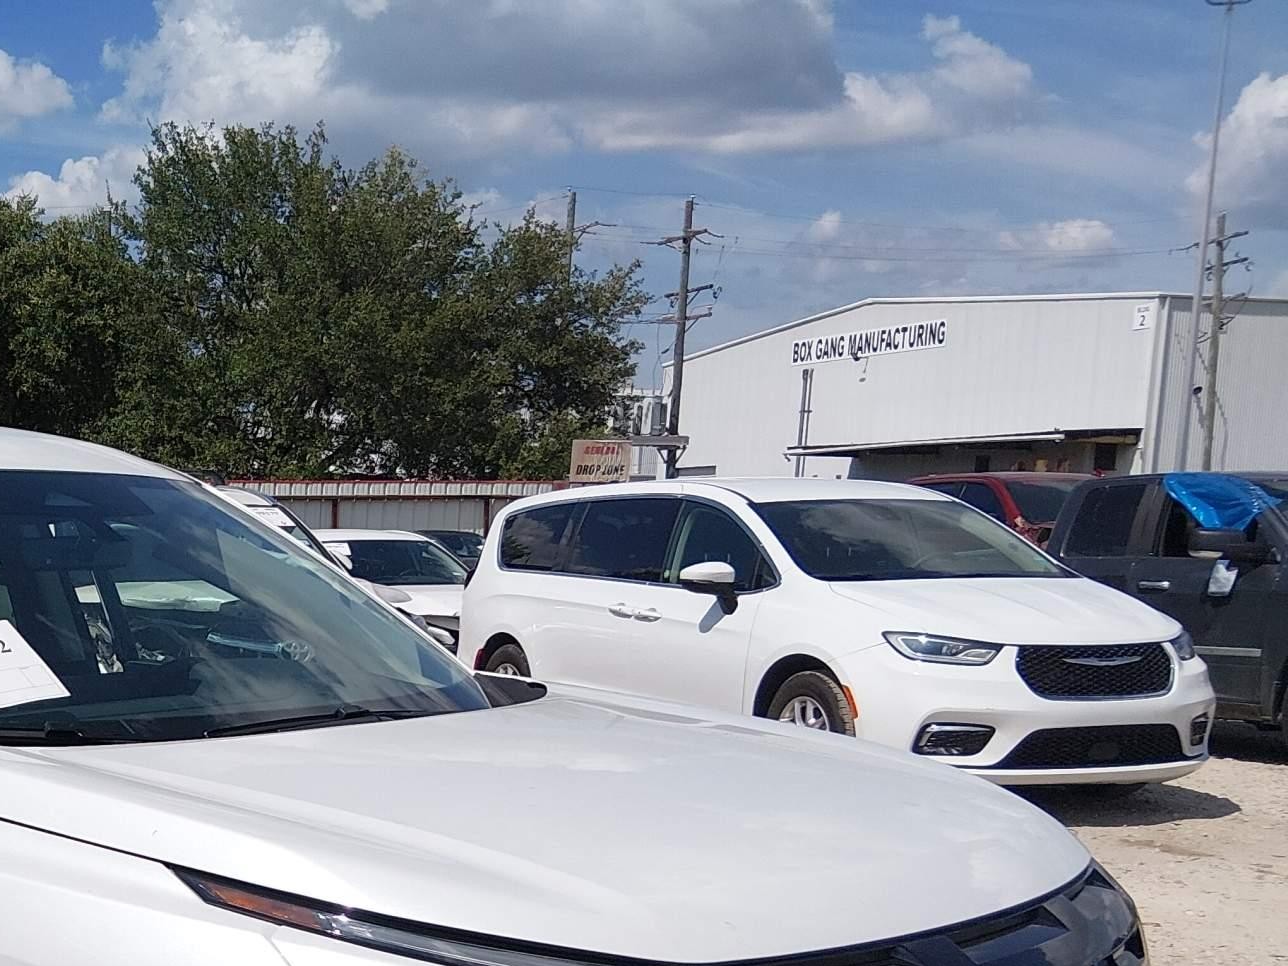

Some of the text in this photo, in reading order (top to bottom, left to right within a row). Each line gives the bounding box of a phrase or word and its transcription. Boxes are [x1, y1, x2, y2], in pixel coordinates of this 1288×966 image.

[1139, 315, 1146, 326] 2
[792, 321, 946, 363] BOX GANG MANUFACTURING
[576, 464, 602, 476] DROP
